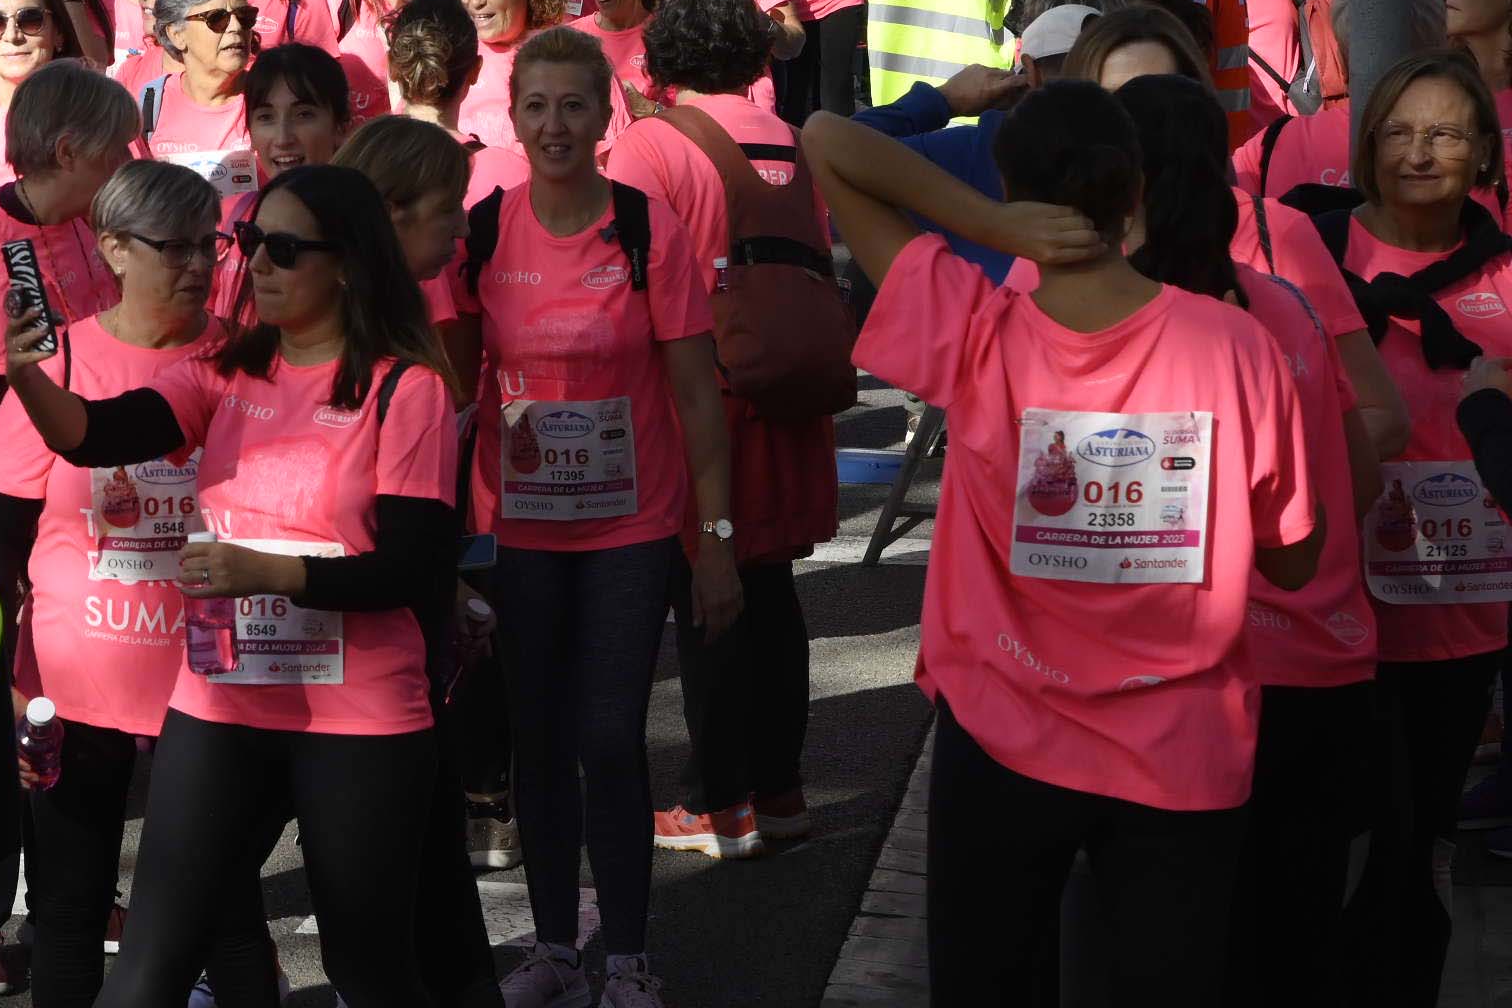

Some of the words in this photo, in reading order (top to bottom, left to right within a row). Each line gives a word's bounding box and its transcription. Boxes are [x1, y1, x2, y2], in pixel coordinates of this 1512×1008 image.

[157, 142, 199, 153] OYSHO
[540, 420, 592, 432] ASTURIANA
[1162, 435, 1196, 445] SUMA
[1083, 441, 1148, 458] ASTURIANA
[544, 449, 589, 465] 016
[140, 467, 196, 479] ASTURIANA
[550, 470, 585, 481] 17395
[1083, 480, 1144, 504] 016
[1420, 487, 1475, 499] ASTURIANA
[143, 496, 196, 517] 016
[514, 500, 554, 512] OYSHO
[585, 498, 626, 509] Santander
[1088, 513, 1135, 528] 23358
[153, 522, 185, 534] 8548
[1421, 518, 1472, 538] 016
[112, 540, 152, 549] CARRERA
[154, 540, 166, 548] DE
[168, 539, 180, 548] LA
[1036, 532, 1088, 543] CARRERA
[1091, 534, 1106, 544] DE
[1108, 535, 1121, 545] LA
[1123, 534, 1159, 545] MUJER
[1162, 534, 1185, 544] 2023
[1426, 545, 1467, 557] 21125
[108, 558, 155, 570] OYSHO
[1028, 552, 1088, 570] OYSHO
[1134, 557, 1188, 569] Santander
[1430, 564, 1443, 572] DE
[239, 597, 287, 618] 016
[1250, 613, 1291, 630] SHO
[246, 623, 277, 636] 8549
[246, 642, 257, 651] DE
[259, 642, 269, 651] LA
[271, 642, 303, 652] MUJER
[281, 661, 330, 673] Santander
